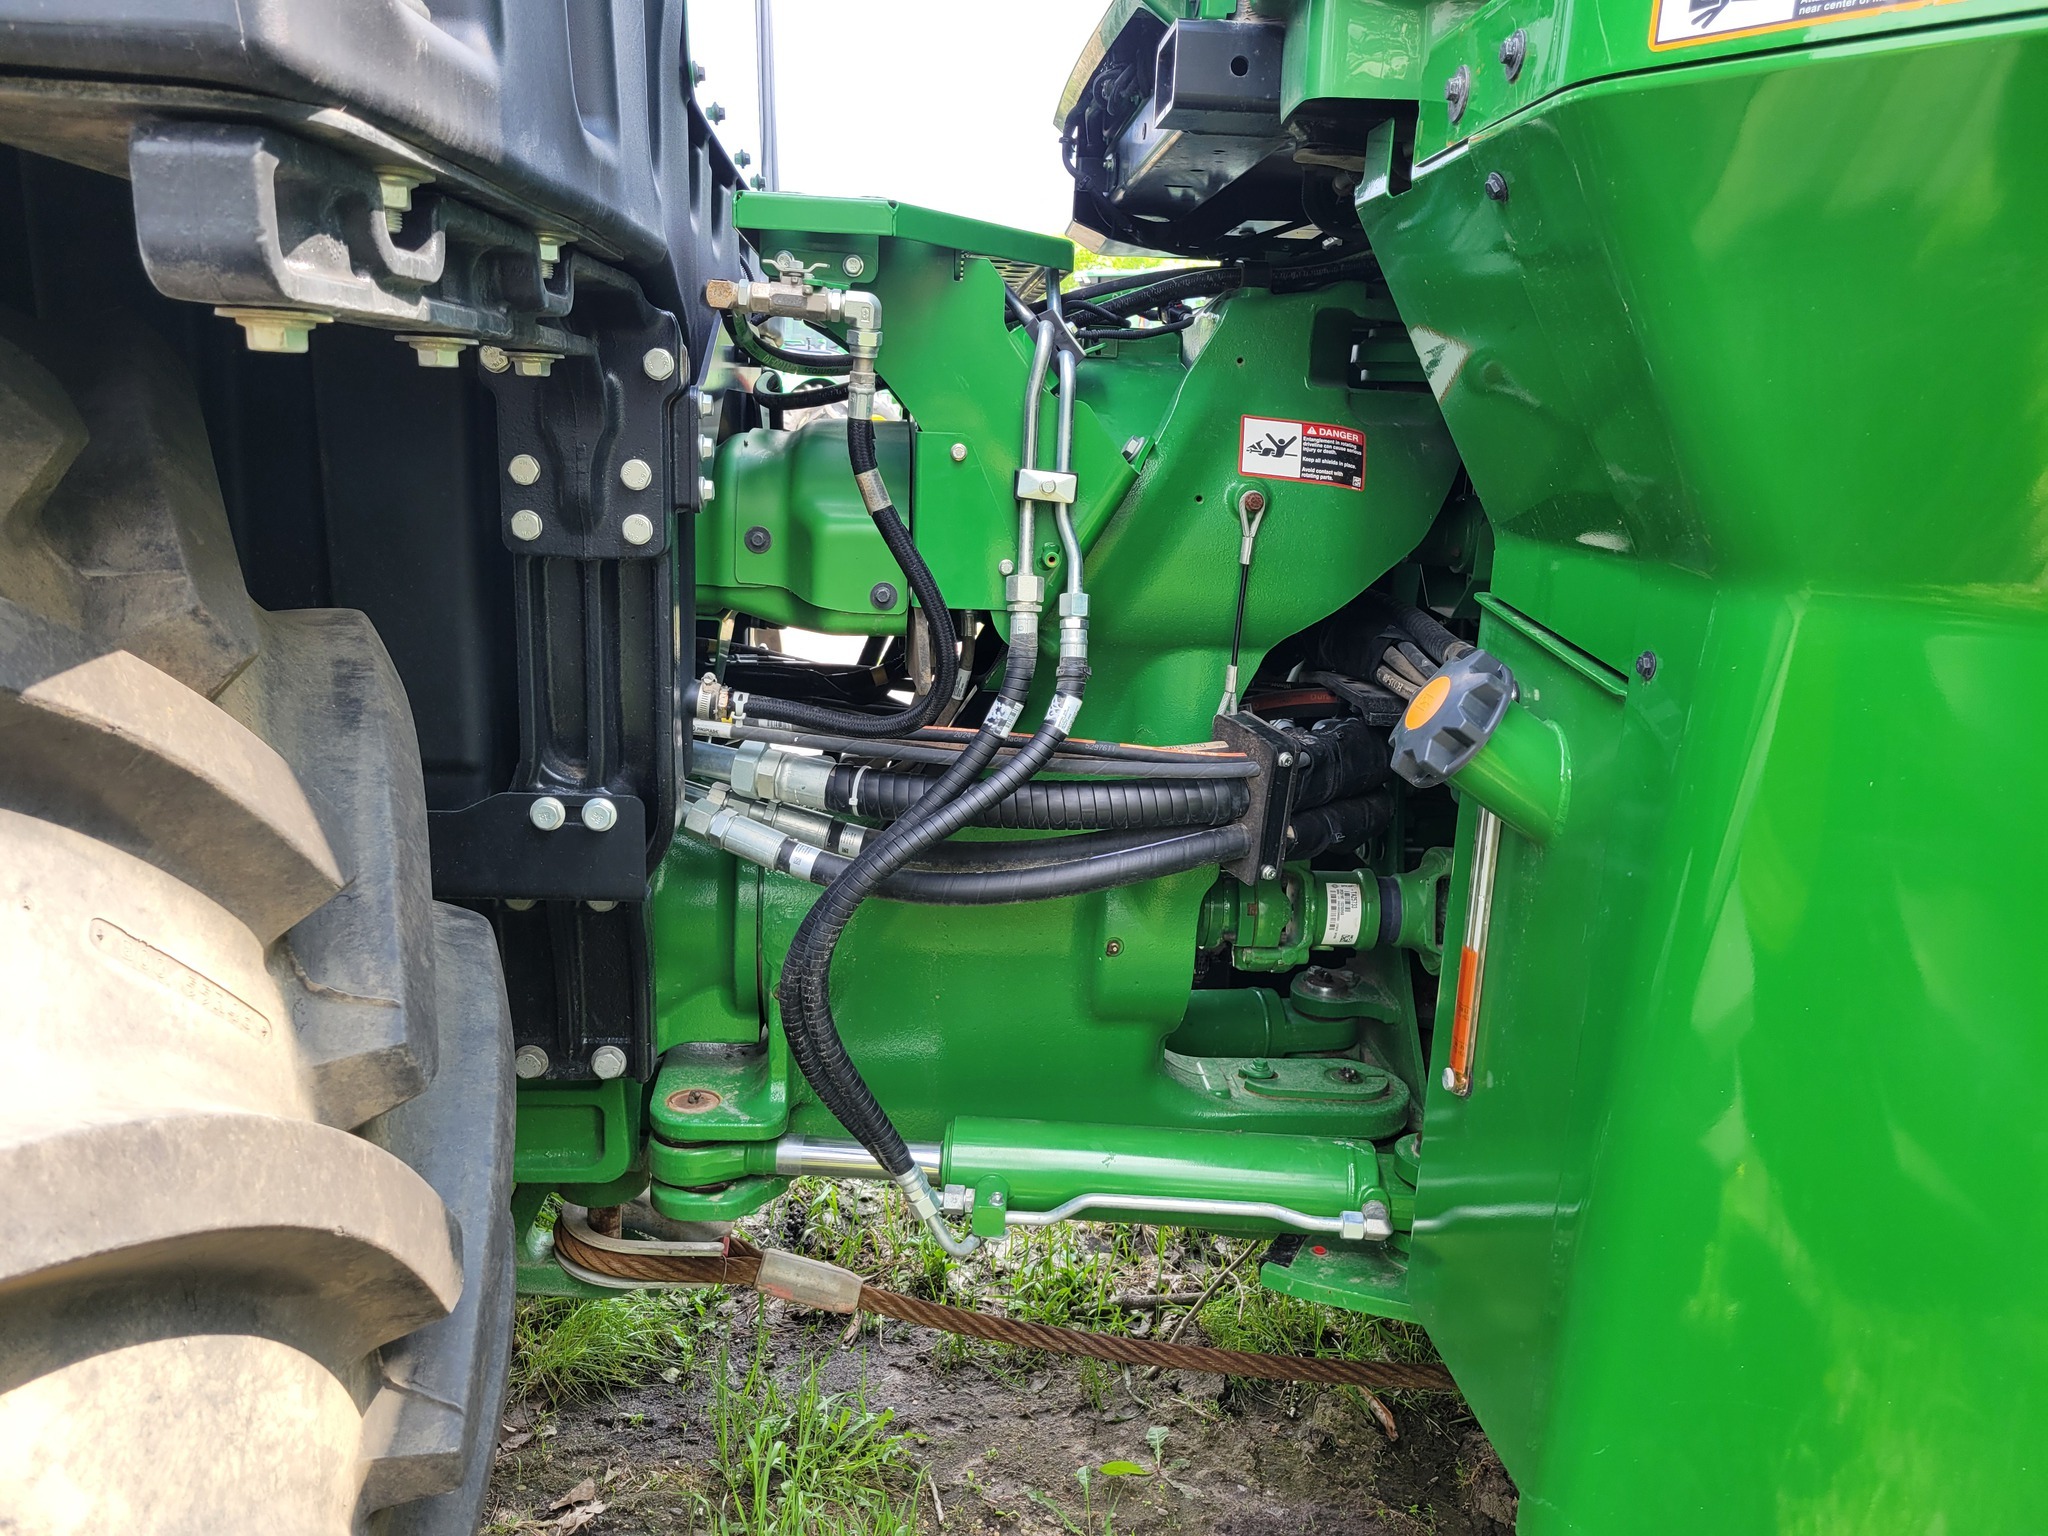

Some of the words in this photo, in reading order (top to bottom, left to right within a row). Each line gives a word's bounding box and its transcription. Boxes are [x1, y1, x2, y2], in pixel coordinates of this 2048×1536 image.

[1798, 5, 1821, 15] near
[1823, 0, 1855, 11] center
[1319, 428, 1358, 442] DANGER
[1303, 436, 1335, 444] Entanglement
[1341, 441, 1357, 450] rotating
